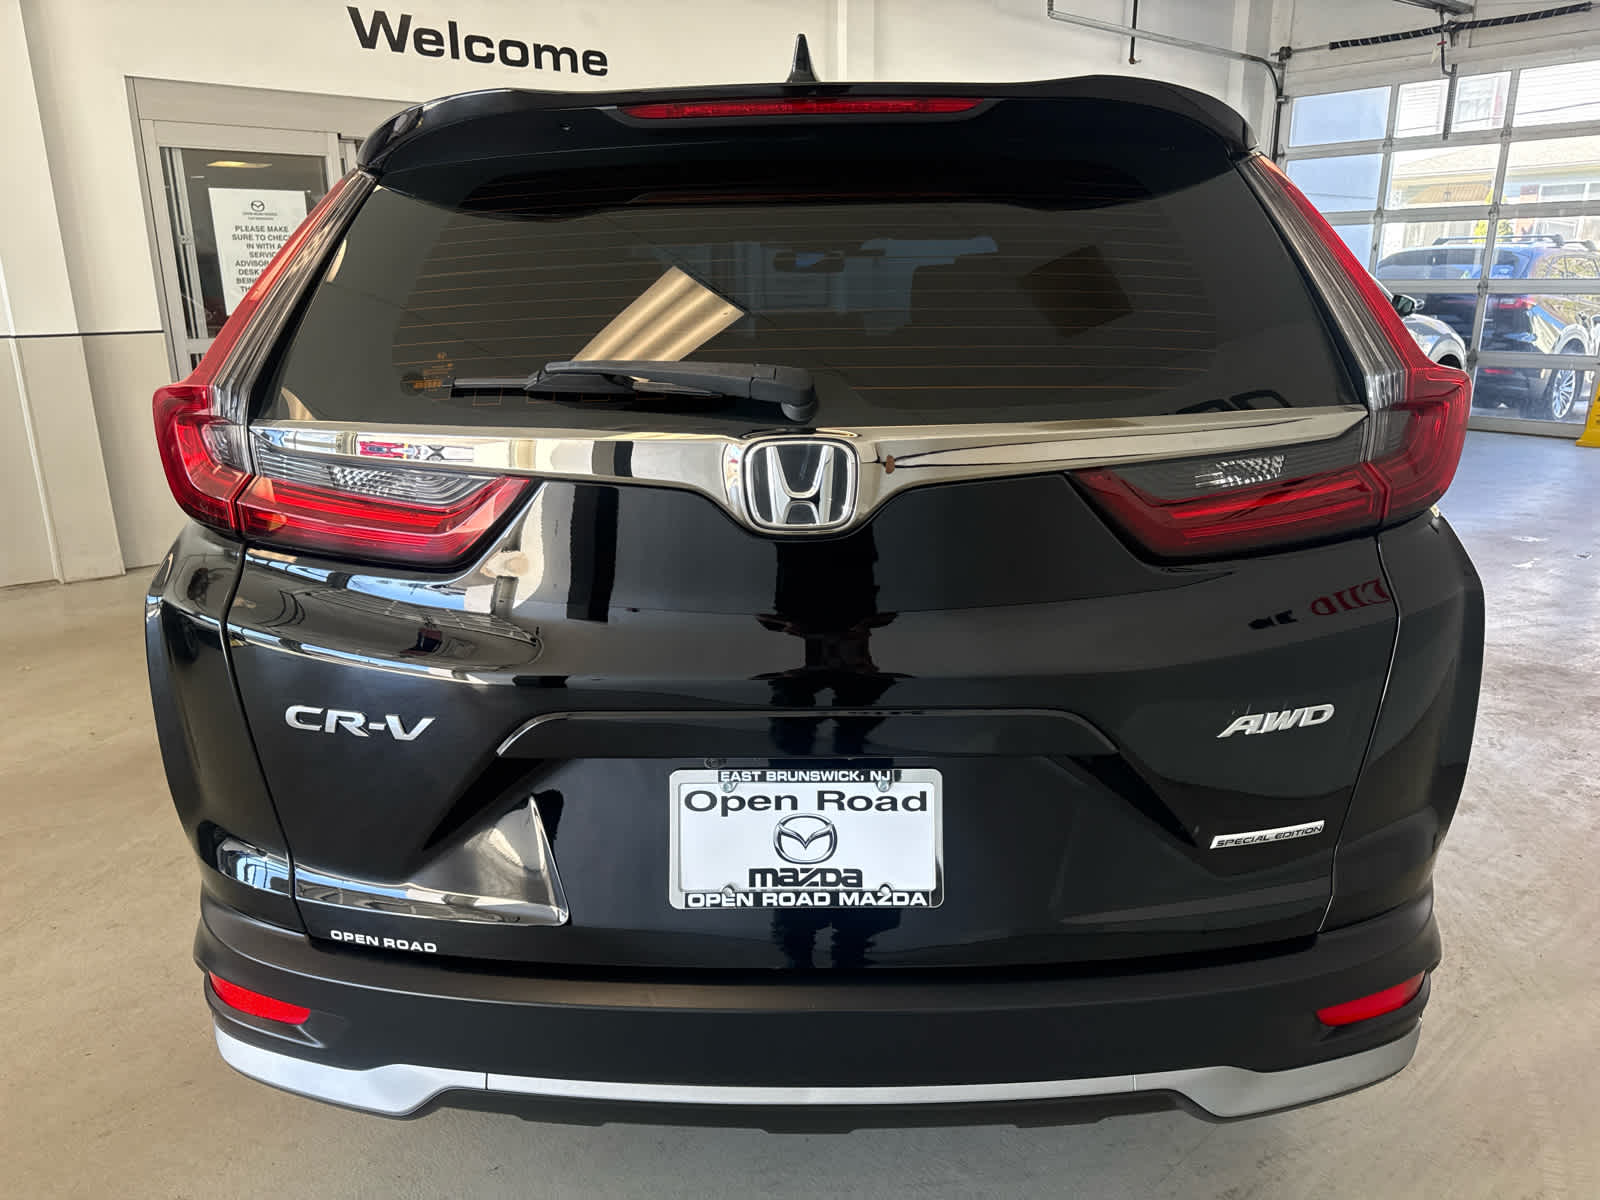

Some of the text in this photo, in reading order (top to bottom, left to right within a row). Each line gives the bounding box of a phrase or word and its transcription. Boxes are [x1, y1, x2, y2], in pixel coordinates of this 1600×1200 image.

[347, 6, 608, 76] Welcome
[285, 705, 436, 741] CR-V
[1216, 703, 1335, 738] AWD
[720, 770, 891, 783] EAST BRUNSWICK, NJ
[684, 790, 928, 817] Open Road
[1215, 825, 1323, 847] SPECIAL EDITION
[687, 892, 928, 907] OPEN ROAD MAZDA
[330, 929, 438, 953] OPEN ROAD
